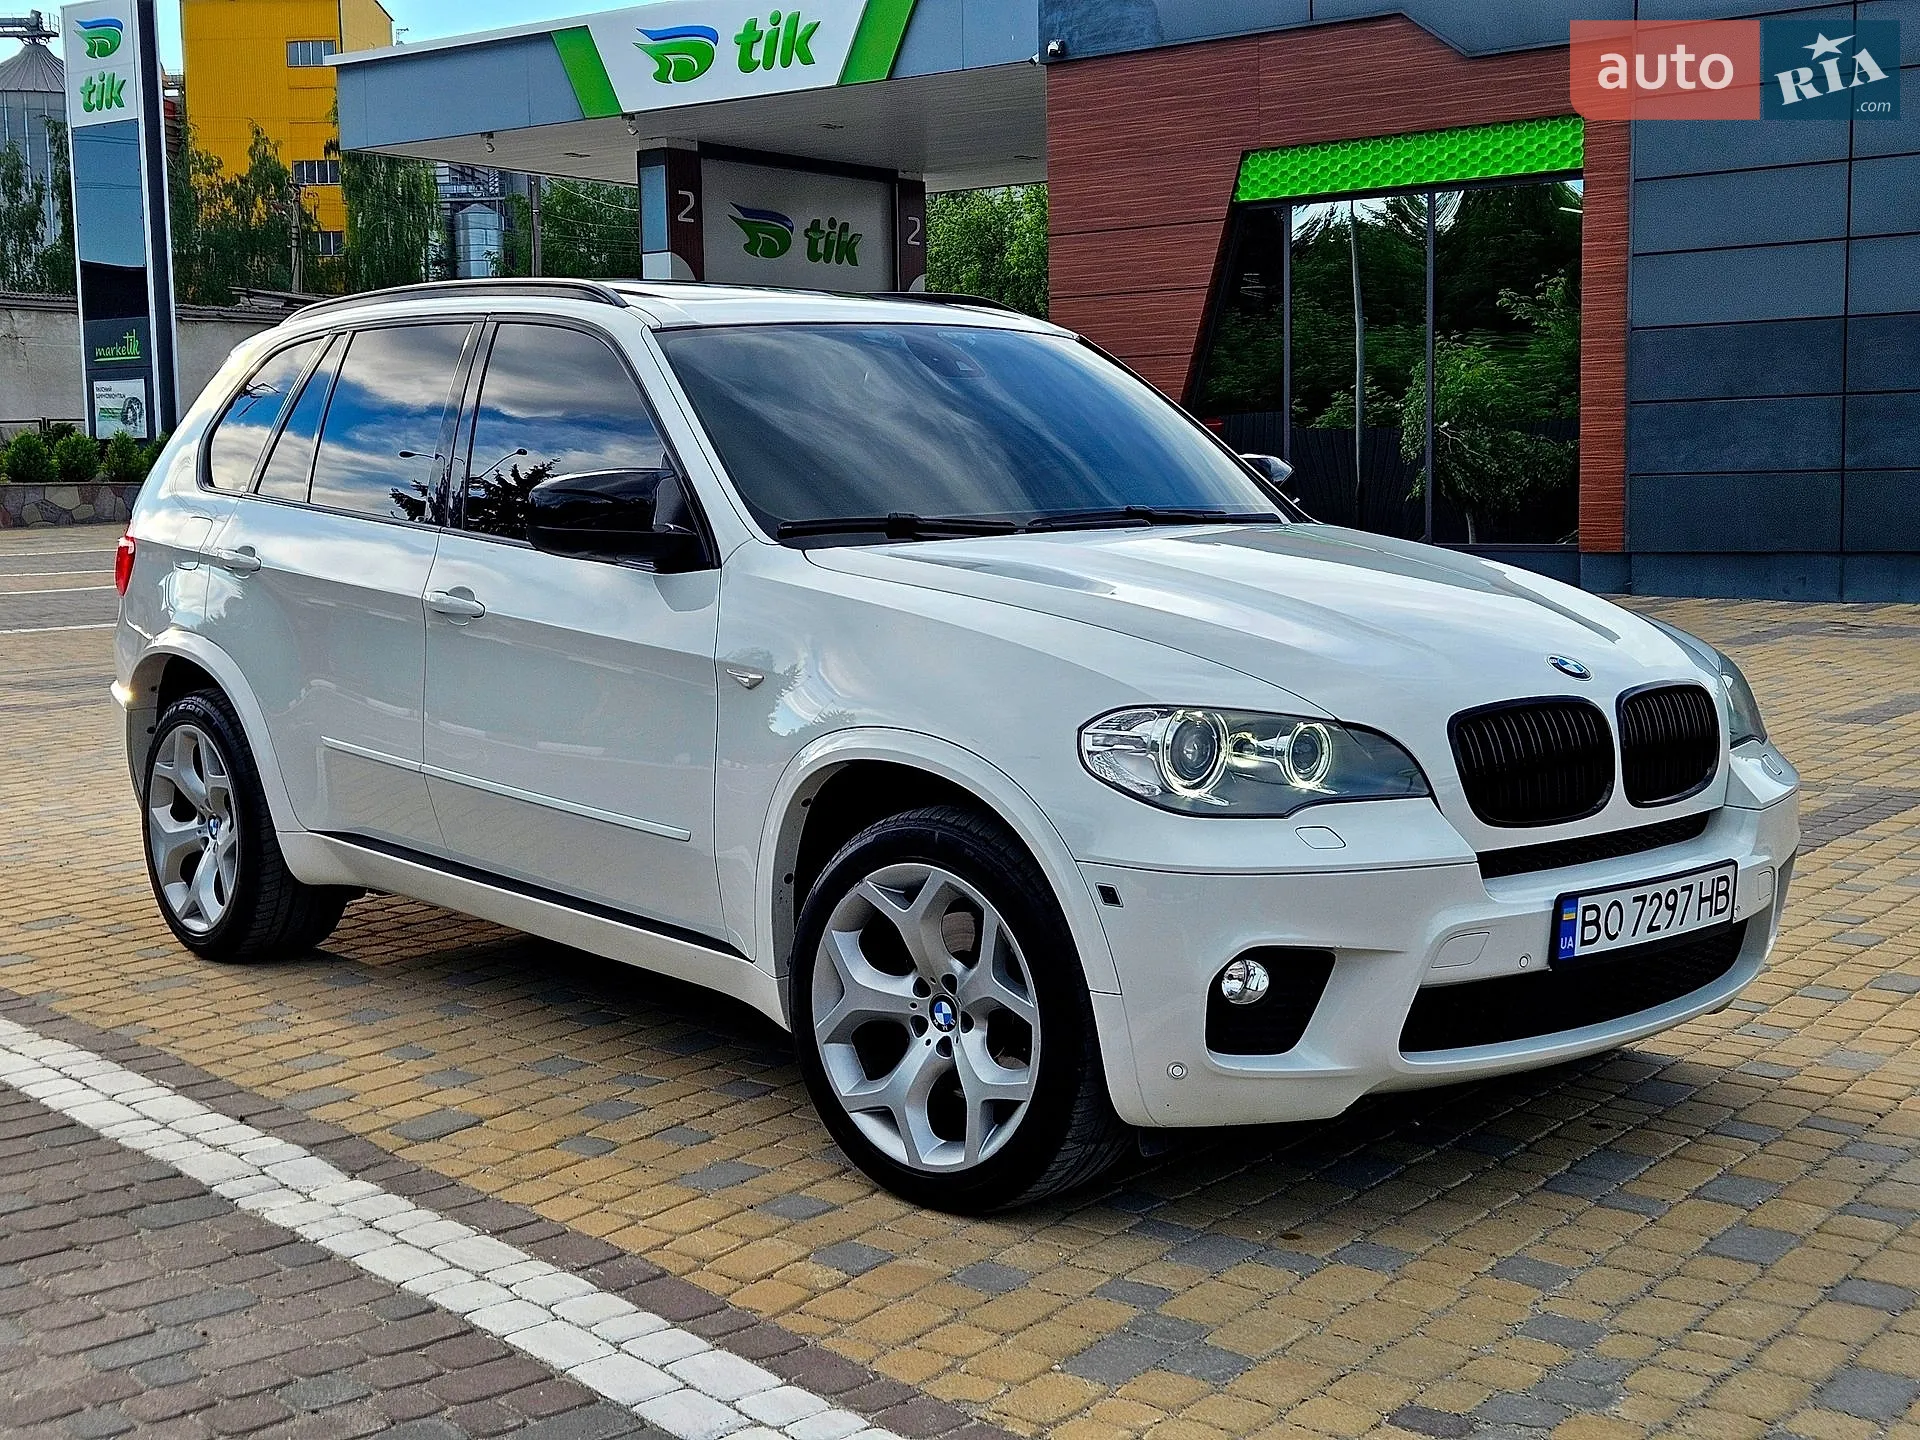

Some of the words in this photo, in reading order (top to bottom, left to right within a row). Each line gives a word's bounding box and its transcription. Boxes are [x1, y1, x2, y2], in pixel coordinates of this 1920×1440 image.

[734, 10, 821, 73] tik
[80, 71, 126, 113] tik
[677, 190, 695, 223] 2
[803, 216, 863, 267] tik
[906, 216, 921, 246] 2
[1579, 899, 1624, 947] BO
[1630, 883, 1694, 937] 7297
[1696, 874, 1731, 921] HB
[1560, 936, 1574, 950] UA
